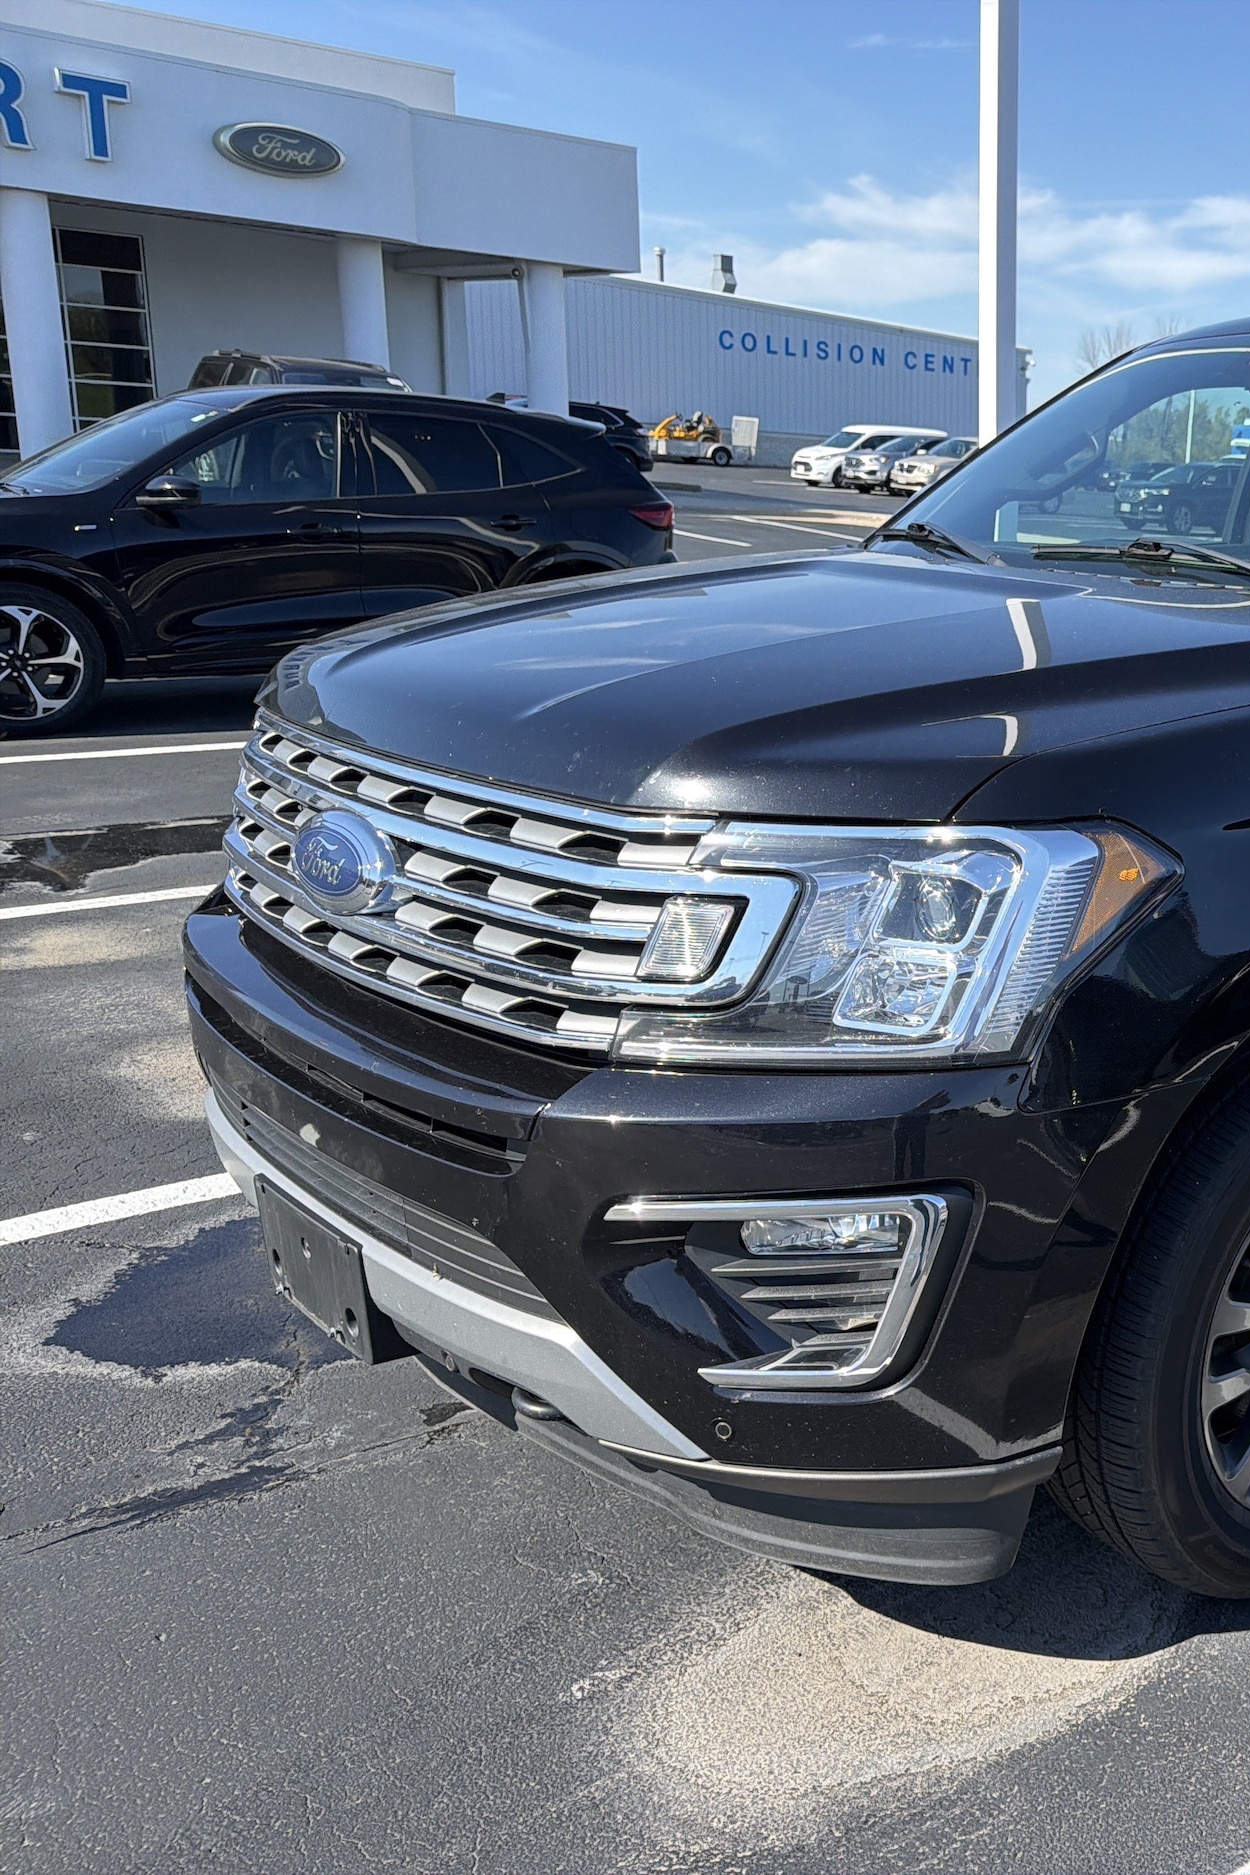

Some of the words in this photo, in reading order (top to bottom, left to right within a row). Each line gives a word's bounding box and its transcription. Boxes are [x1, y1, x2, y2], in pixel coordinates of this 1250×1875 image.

[252, 133, 316, 166] Ford
[718, 329, 886, 367] COLLISION
[904, 350, 972, 377] CENT
[301, 836, 346, 885] Ford
